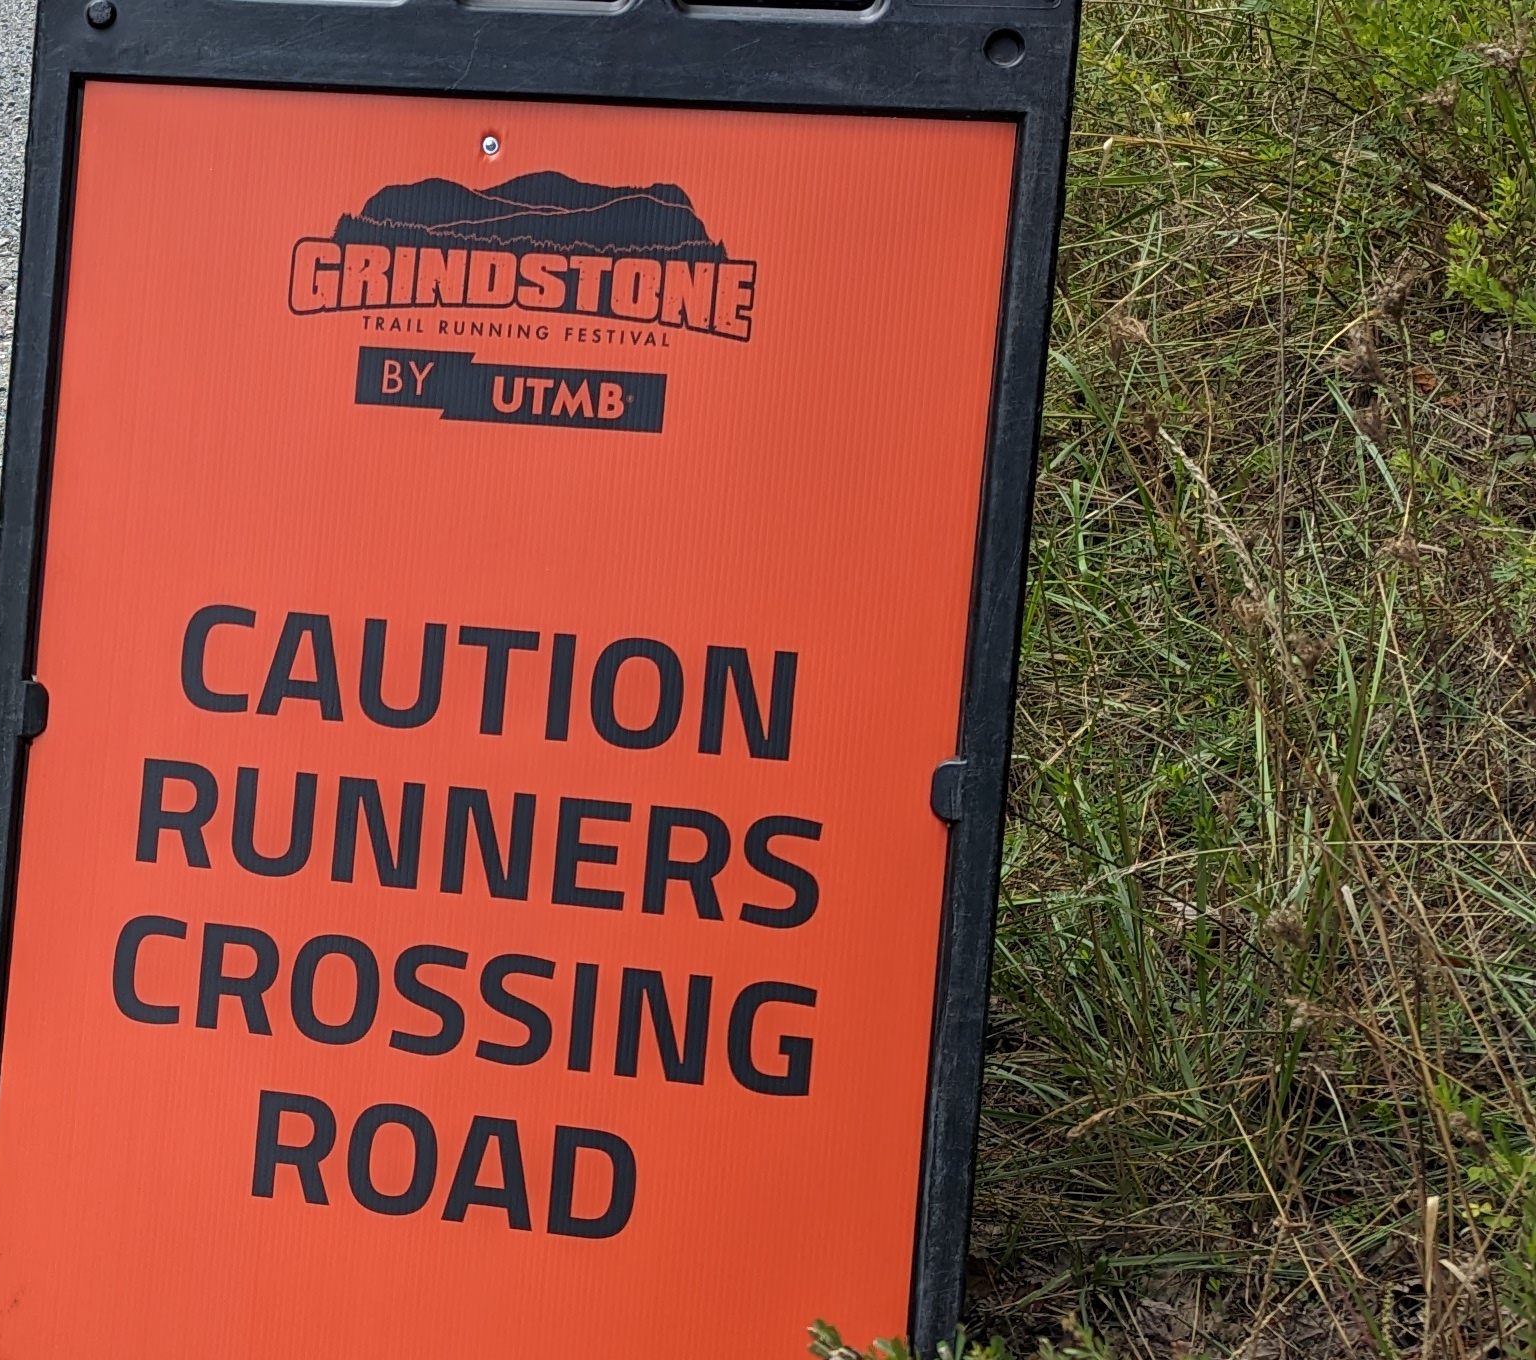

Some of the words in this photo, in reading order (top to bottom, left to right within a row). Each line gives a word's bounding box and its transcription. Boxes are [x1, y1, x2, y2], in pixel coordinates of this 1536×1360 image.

[288, 237, 757, 343] GRINDSTONE
[363, 315, 425, 334] TRAIL
[438, 319, 550, 341] RUNNING
[564, 326, 671, 348] FESTIVAL
[381, 359, 434, 396] BY
[180, 604, 799, 762] CAUTION
[135, 757, 824, 929] RUNNERS
[111, 915, 818, 1097] CROSSING
[251, 1089, 638, 1240] ROAD
